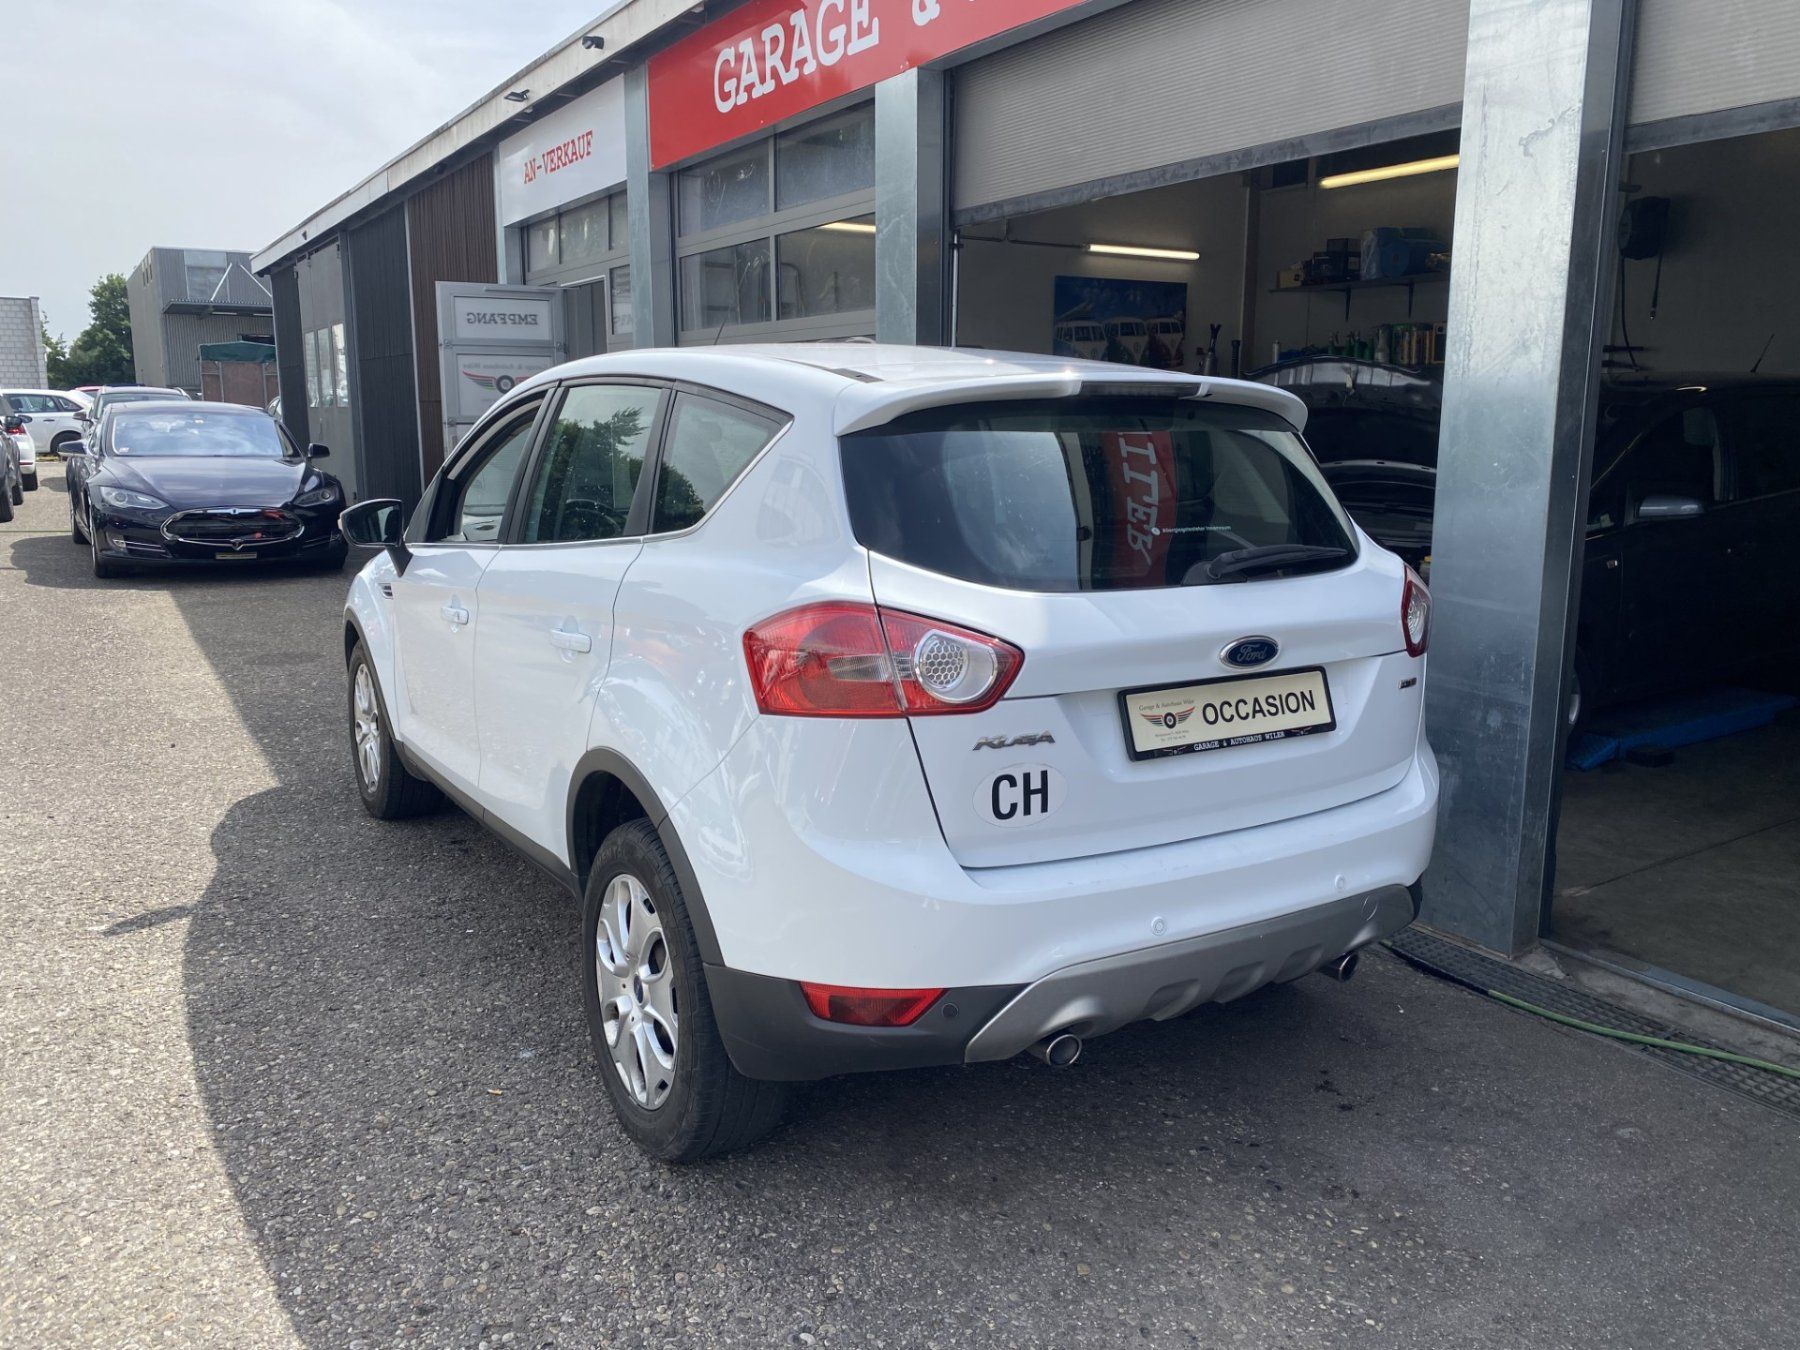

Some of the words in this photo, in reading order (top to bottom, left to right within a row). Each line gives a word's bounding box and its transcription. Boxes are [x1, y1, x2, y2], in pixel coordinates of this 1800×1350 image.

[714, 0, 879, 113] GARAGE
[524, 130, 593, 184] AN-VERKAUF
[1236, 643, 1268, 662] Ford
[1202, 689, 1316, 725] OCCASION
[1193, 740, 1220, 751] GARAGE
[991, 769, 1048, 821] CH
